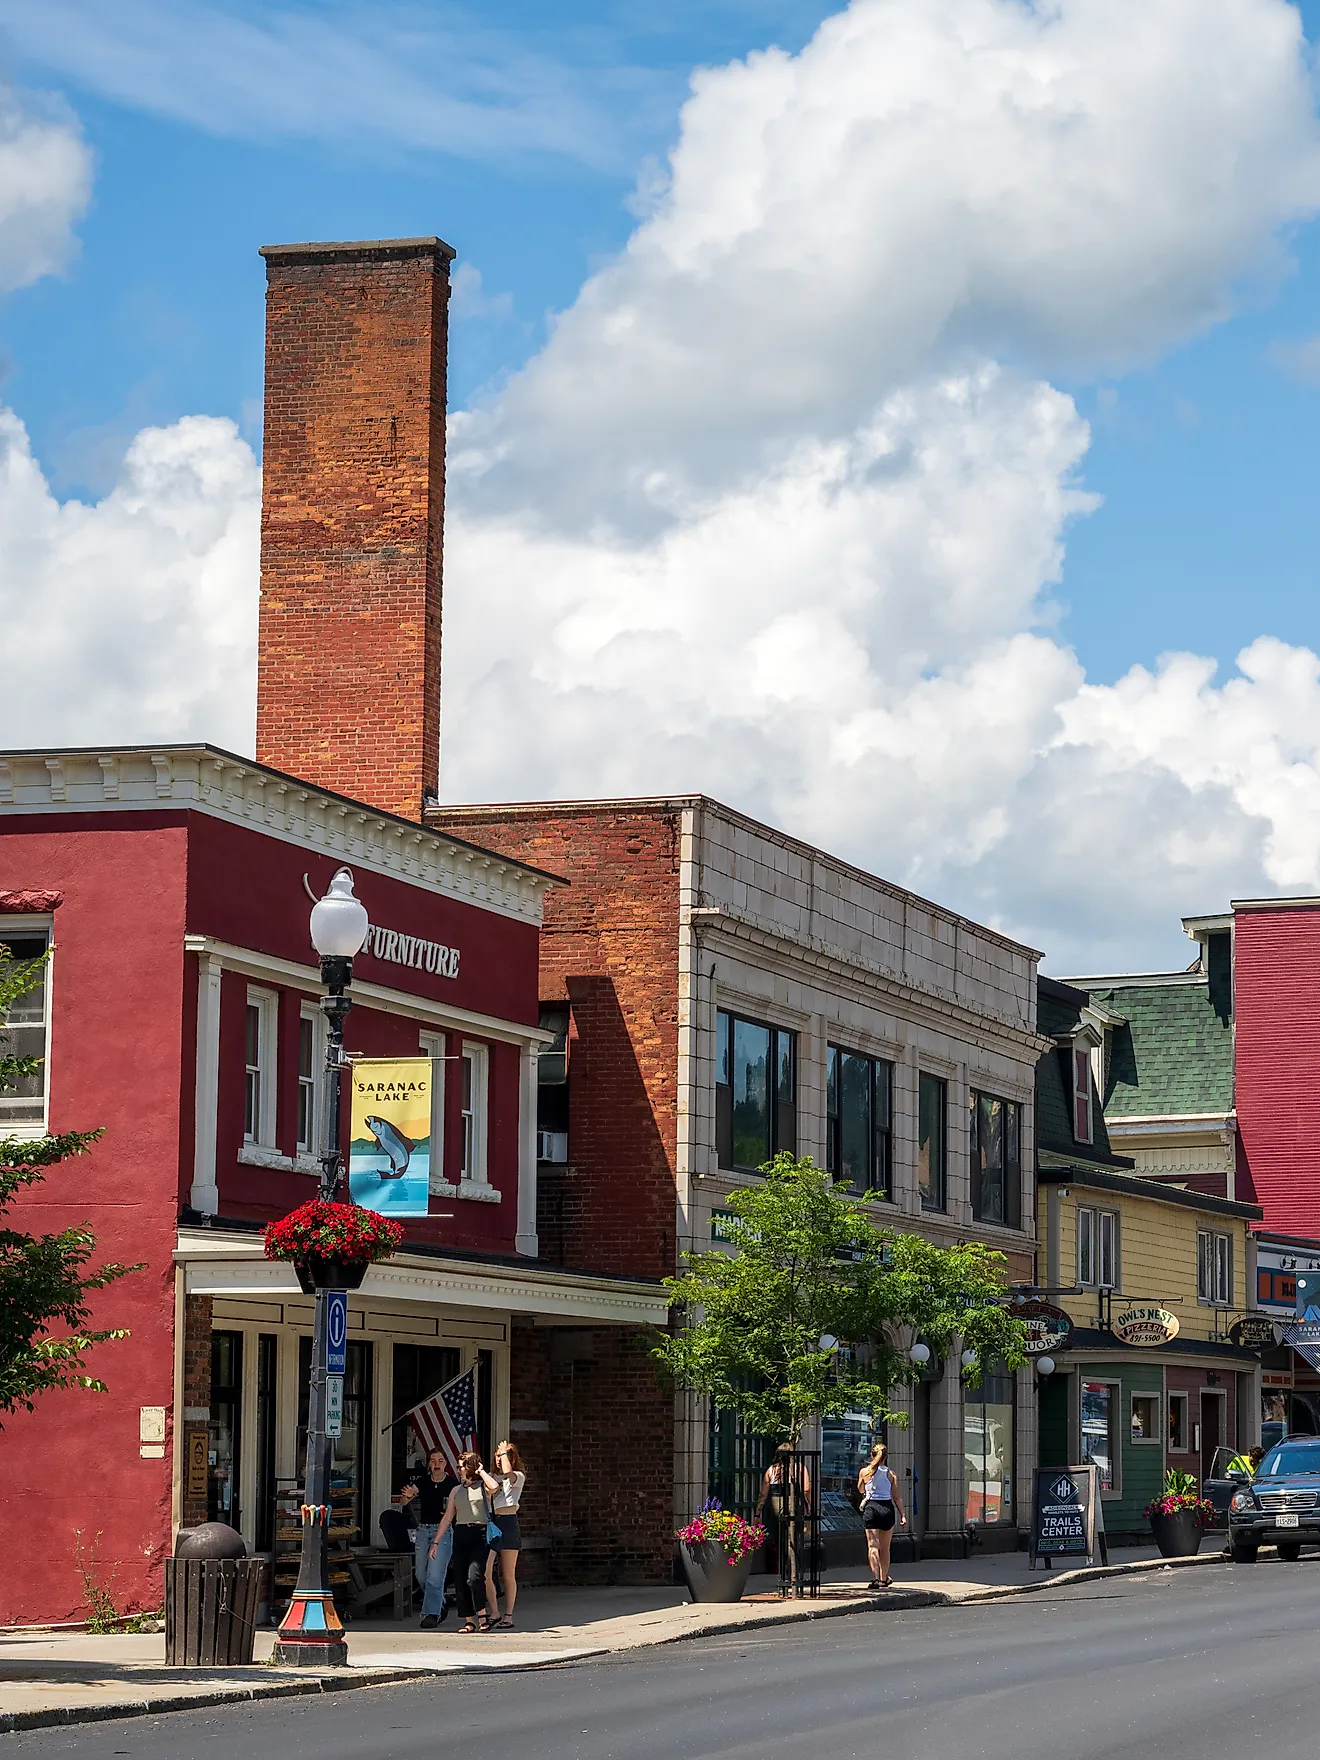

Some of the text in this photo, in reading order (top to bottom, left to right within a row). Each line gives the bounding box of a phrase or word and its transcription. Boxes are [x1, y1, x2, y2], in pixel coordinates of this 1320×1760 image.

[361, 923, 461, 979] FURNITURE
[357, 1081, 427, 1092] SARANAC
[375, 1092, 410, 1102] LAKE
[1118, 1308, 1174, 1326] OWL'S NEST
[1025, 1321, 1045, 1330] INE
[1126, 1323, 1167, 1335] PIZZERIA
[1129, 1334, 1161, 1343] 891-5500
[331, 1383, 338, 1394] 30
[327, 1410, 341, 1421] PARKING
[1044, 1516, 1081, 1527] TRAILS
[1041, 1526, 1083, 1537] CENTER
